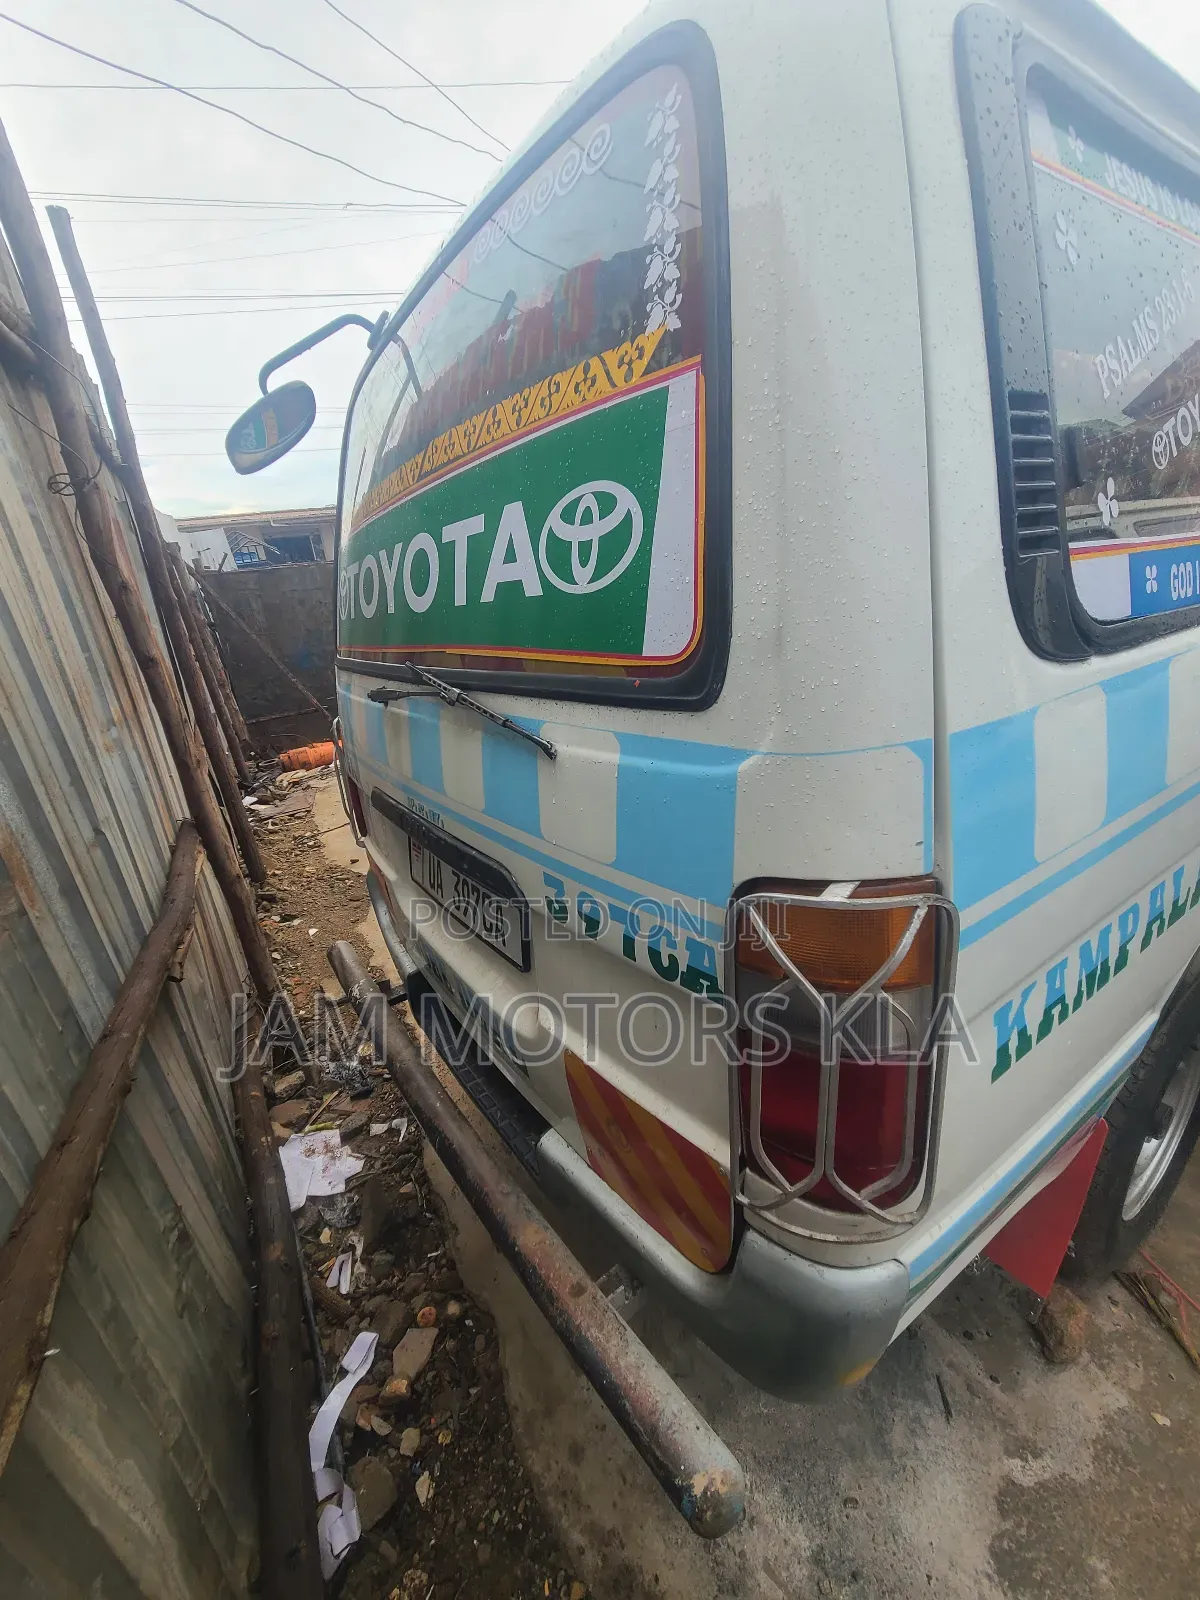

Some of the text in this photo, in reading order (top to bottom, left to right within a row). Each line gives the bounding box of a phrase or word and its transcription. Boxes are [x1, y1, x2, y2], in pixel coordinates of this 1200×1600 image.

[1095, 305, 1160, 400] PSALMS
[346, 500, 543, 620] TOYOTA
[1170, 561, 1194, 601] GOD
[542, 871, 724, 1008] 397CA
